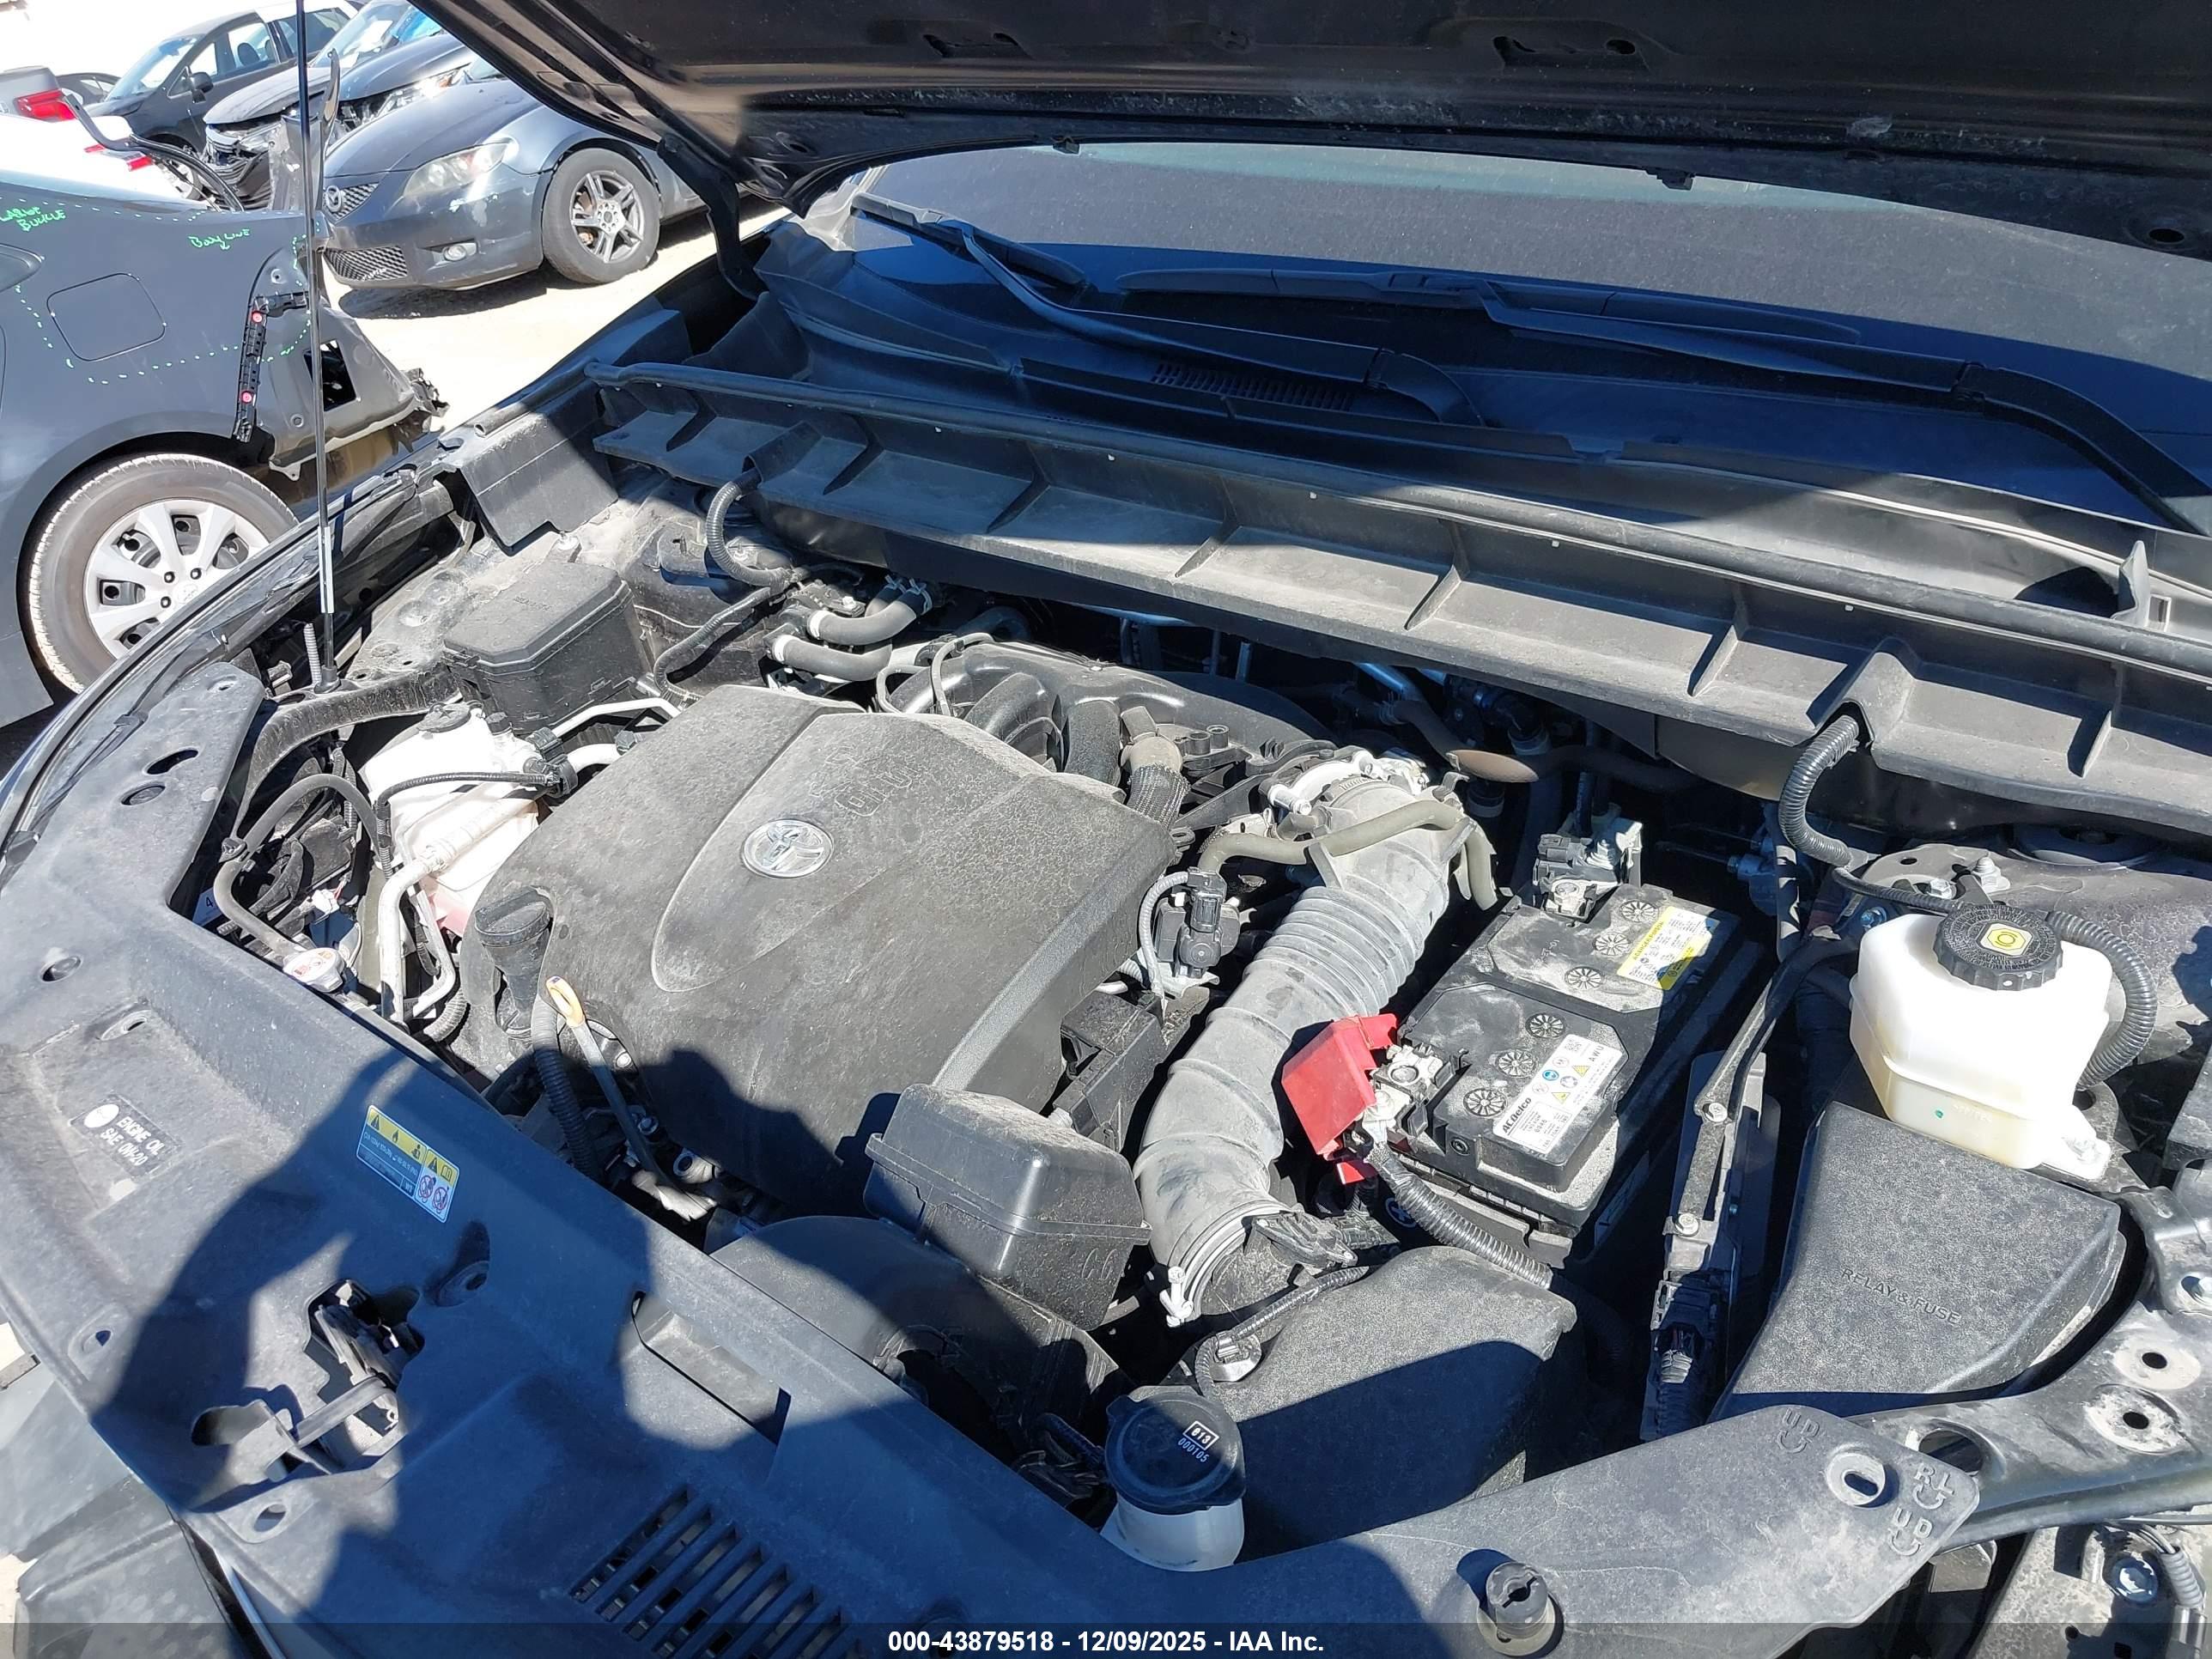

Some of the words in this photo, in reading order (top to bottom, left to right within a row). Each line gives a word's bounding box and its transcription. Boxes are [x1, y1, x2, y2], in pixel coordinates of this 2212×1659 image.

[1502, 1097, 1533, 1134] ACDelco
[100, 1127, 125, 1146] SAE
[117, 1142, 149, 1167] 0W-20
[116, 1115, 153, 1144] ENGINE
[144, 1139, 166, 1156] OIL
[1840, 1267, 1897, 1297] RELAY
[1897, 1291, 1910, 1304] &
[1913, 1297, 1961, 1325] FUSE
[1177, 1437, 1210, 1462] 000105
[1190, 1426, 1212, 1444] e13
